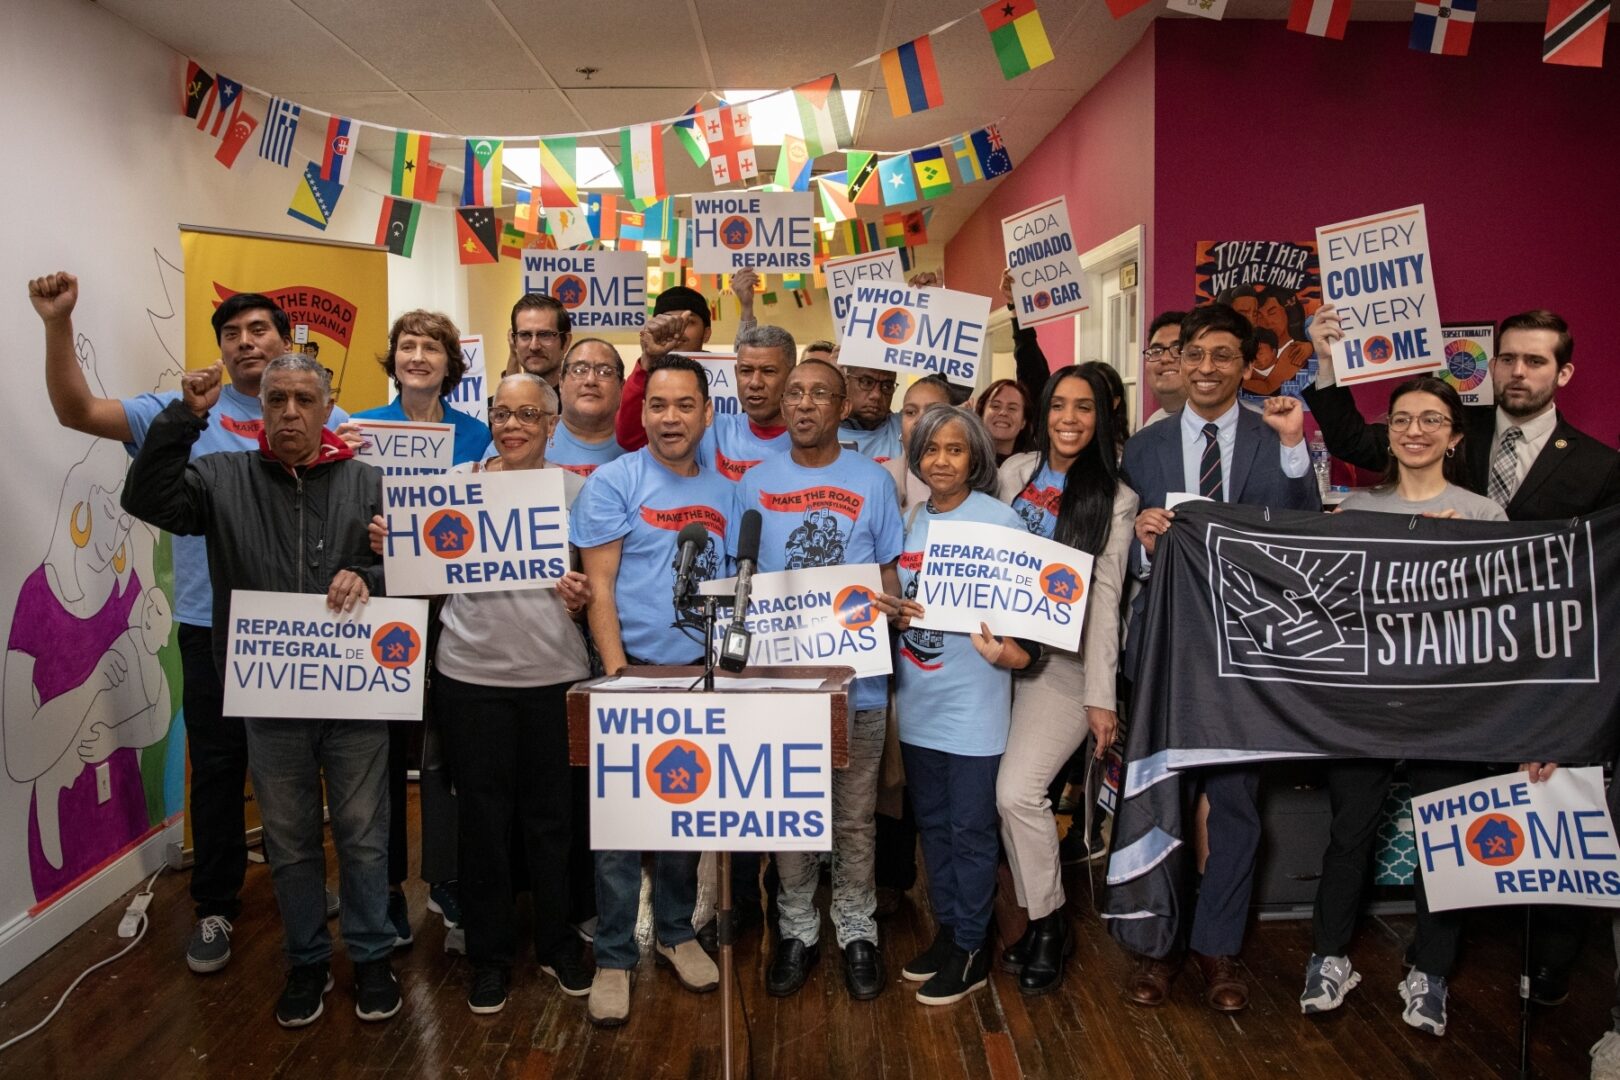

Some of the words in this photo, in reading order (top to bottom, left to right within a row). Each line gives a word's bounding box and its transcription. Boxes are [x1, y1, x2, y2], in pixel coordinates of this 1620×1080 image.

[695, 199, 760, 214] WHOLE
[1013, 213, 1060, 241] CADA
[1328, 220, 1415, 262] EVERY
[525, 256, 595, 272] WHOLE
[732, 252, 811, 267] REPAIRS
[1008, 232, 1072, 269] CONDADO
[1214, 240, 1308, 272] TOGETHER
[1021, 260, 1072, 288] CADA
[1212, 269, 1238, 296] WE
[1241, 263, 1268, 284] ARE
[1266, 266, 1305, 290] HOME
[1327, 253, 1424, 300] COUNTY
[277, 292, 307, 309] THE
[311, 294, 352, 323] ROAD
[857, 287, 930, 309] WHOLE
[1336, 293, 1426, 331] EVERY
[569, 311, 646, 326] REPAIRS
[884, 347, 975, 379] REPAIRS
[358, 433, 445, 459] EVERY
[722, 460, 747, 474] MAKE
[386, 483, 483, 507] WHOLE
[771, 495, 802, 505] MAKE
[804, 489, 826, 501] THE
[828, 491, 860, 508] ROAD
[656, 512, 683, 522] MAKE
[684, 509, 702, 520] THE
[446, 557, 565, 584] REPAIRS
[929, 543, 1042, 572] REPARACIÓN
[1371, 556, 1469, 605] LEHIGH
[1475, 533, 1576, 597] VALLEY
[926, 562, 1013, 582] INTEGRAL
[1015, 575, 1033, 587] DE
[715, 590, 831, 619] REARACIÓN
[924, 580, 1072, 625] VIVIENDAS
[236, 618, 372, 639] REPARACIÓN
[1375, 604, 1518, 666] STANDS
[1532, 600, 1583, 659] UP
[235, 639, 342, 659] INTEGRAL
[345, 648, 364, 659] DE
[233, 660, 411, 693] VIVIENDAS
[597, 707, 726, 735] WHOLE
[1418, 782, 1531, 825] WHOLE
[671, 810, 825, 837] REPAIRS
[1494, 868, 1620, 896] REPAIRS
